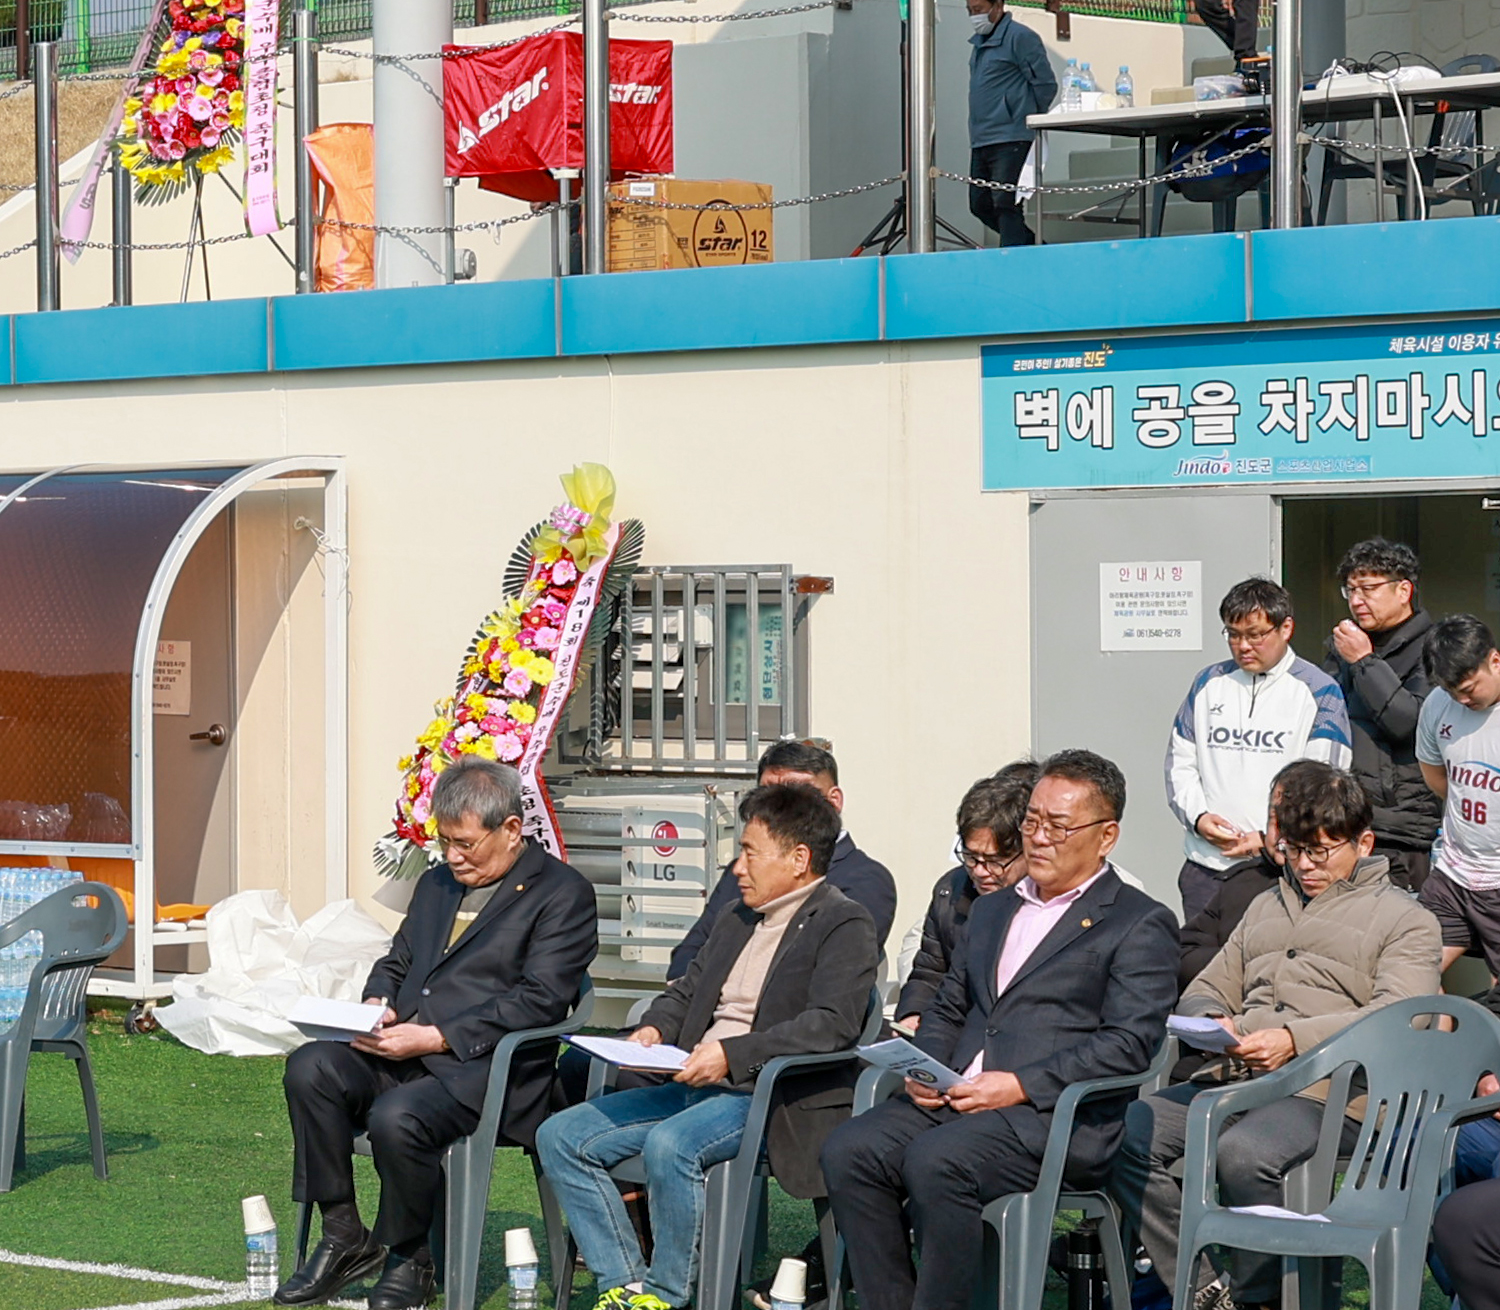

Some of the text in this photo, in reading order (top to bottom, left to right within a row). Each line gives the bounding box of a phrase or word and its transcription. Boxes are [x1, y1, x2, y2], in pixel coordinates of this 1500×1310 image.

[751, 229, 767, 249] 12
[1389, 335, 1445, 354] 체육시설
[1448, 332, 1490, 351] 이용자
[1084, 350, 1106, 368] 진도
[1014, 384, 1116, 451] 벽에
[1132, 379, 1241, 448] 공을
[1174, 458, 1221, 476] Jindo
[1236, 458, 1271, 475] 진도군
[1461, 797, 1487, 825] 96
[653, 862, 676, 881] LG
